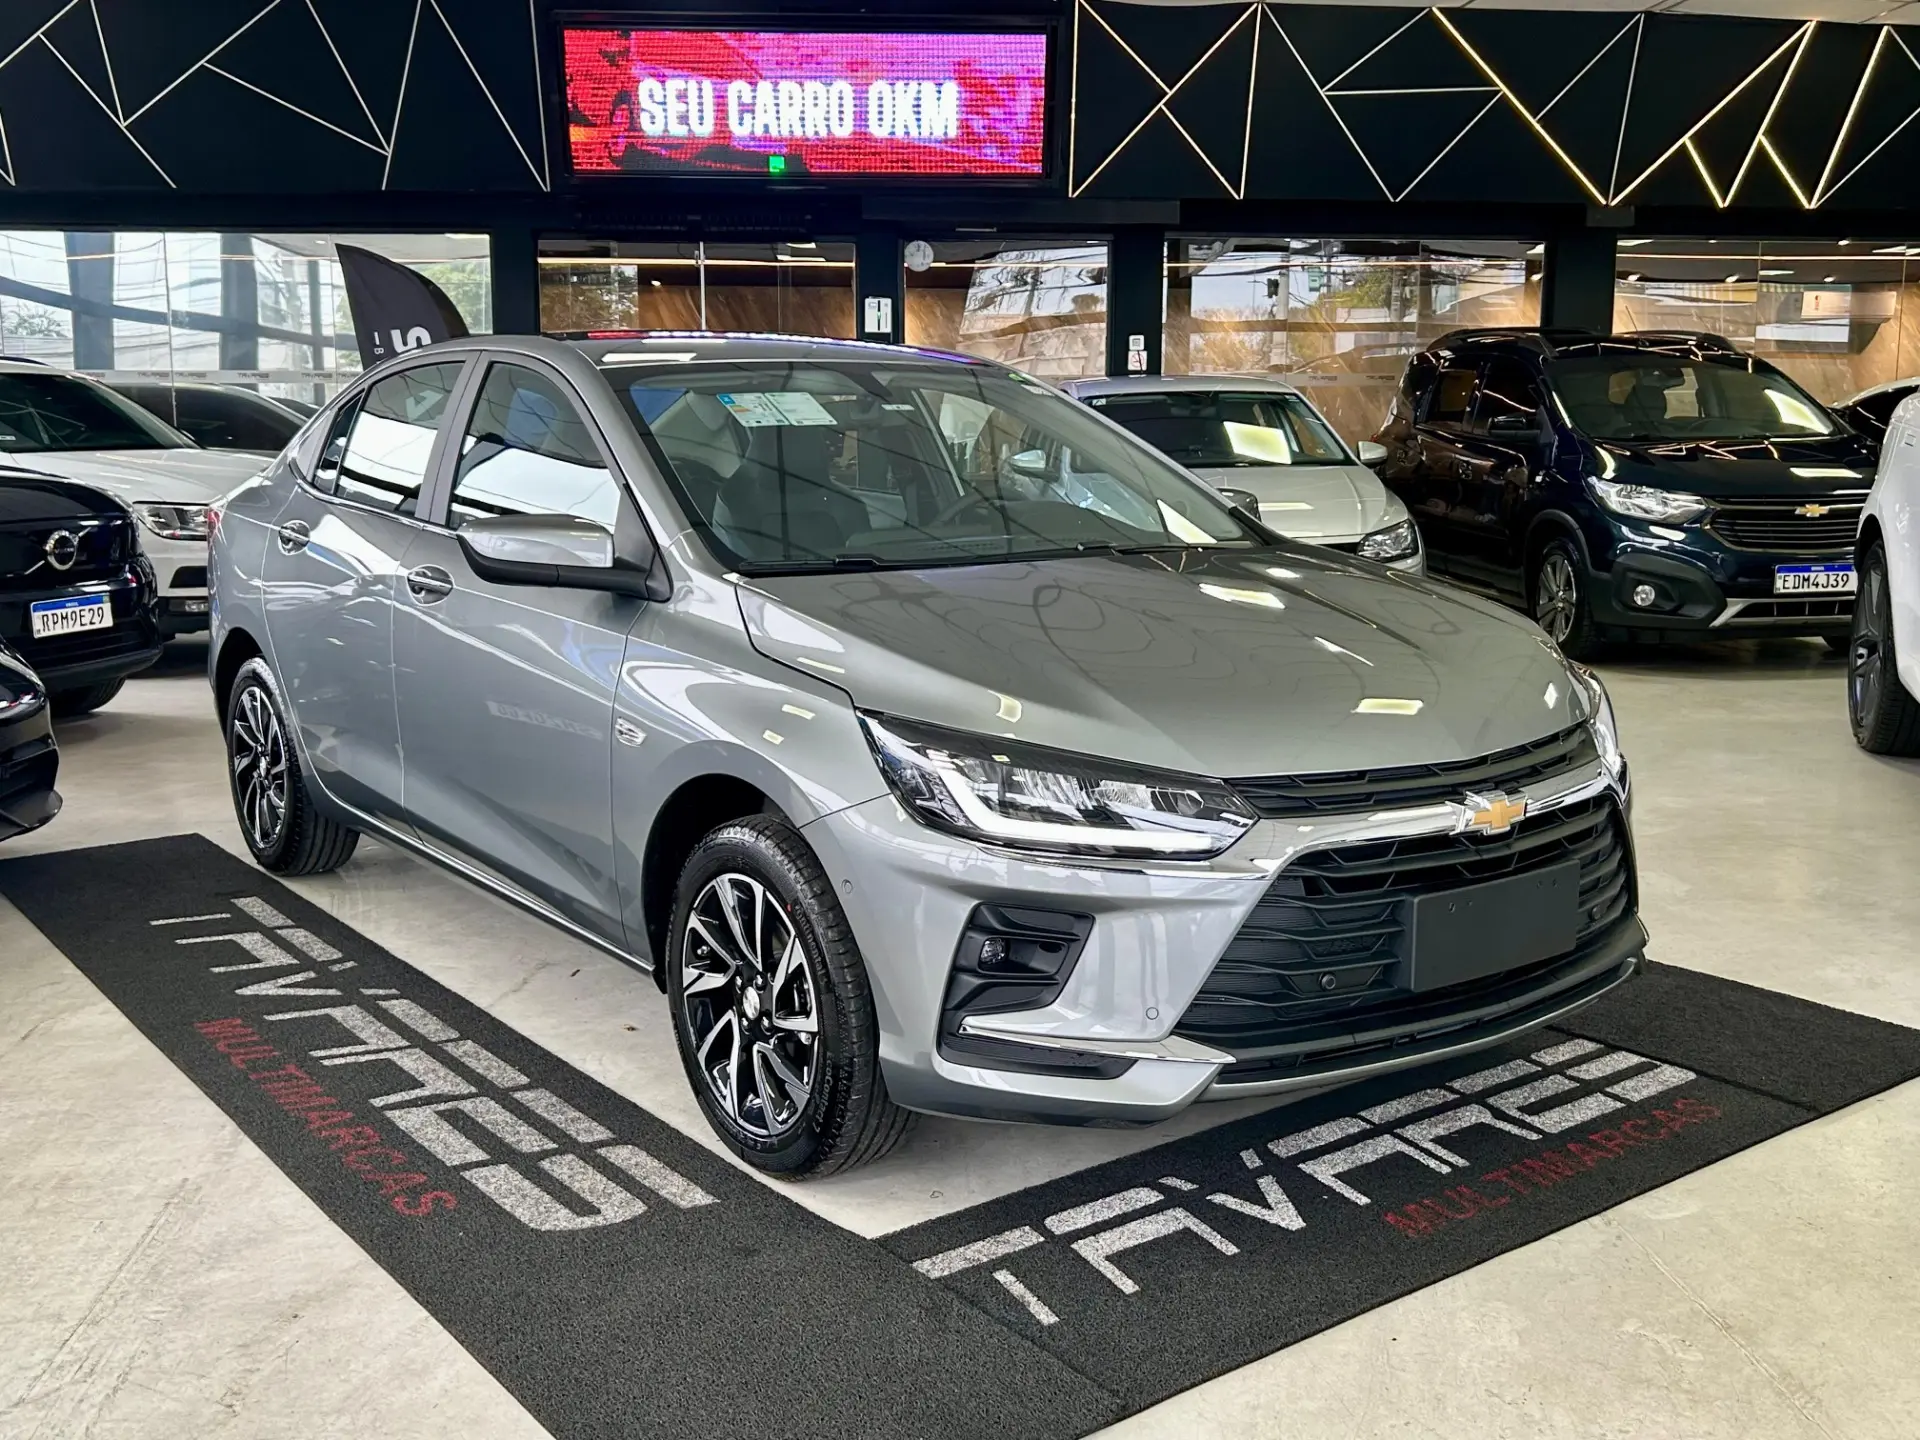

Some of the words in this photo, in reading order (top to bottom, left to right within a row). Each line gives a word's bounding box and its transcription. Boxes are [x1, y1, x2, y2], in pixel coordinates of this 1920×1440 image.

[638, 78, 714, 137] SEU
[727, 80, 854, 138] CARRO
[1782, 573, 1850, 590] EDM4J39
[42, 606, 105, 632] RPM9E29
[193, 1017, 458, 1217] MULTIMARCAS
[1381, 1096, 1722, 1238] MULTIMARCAS
